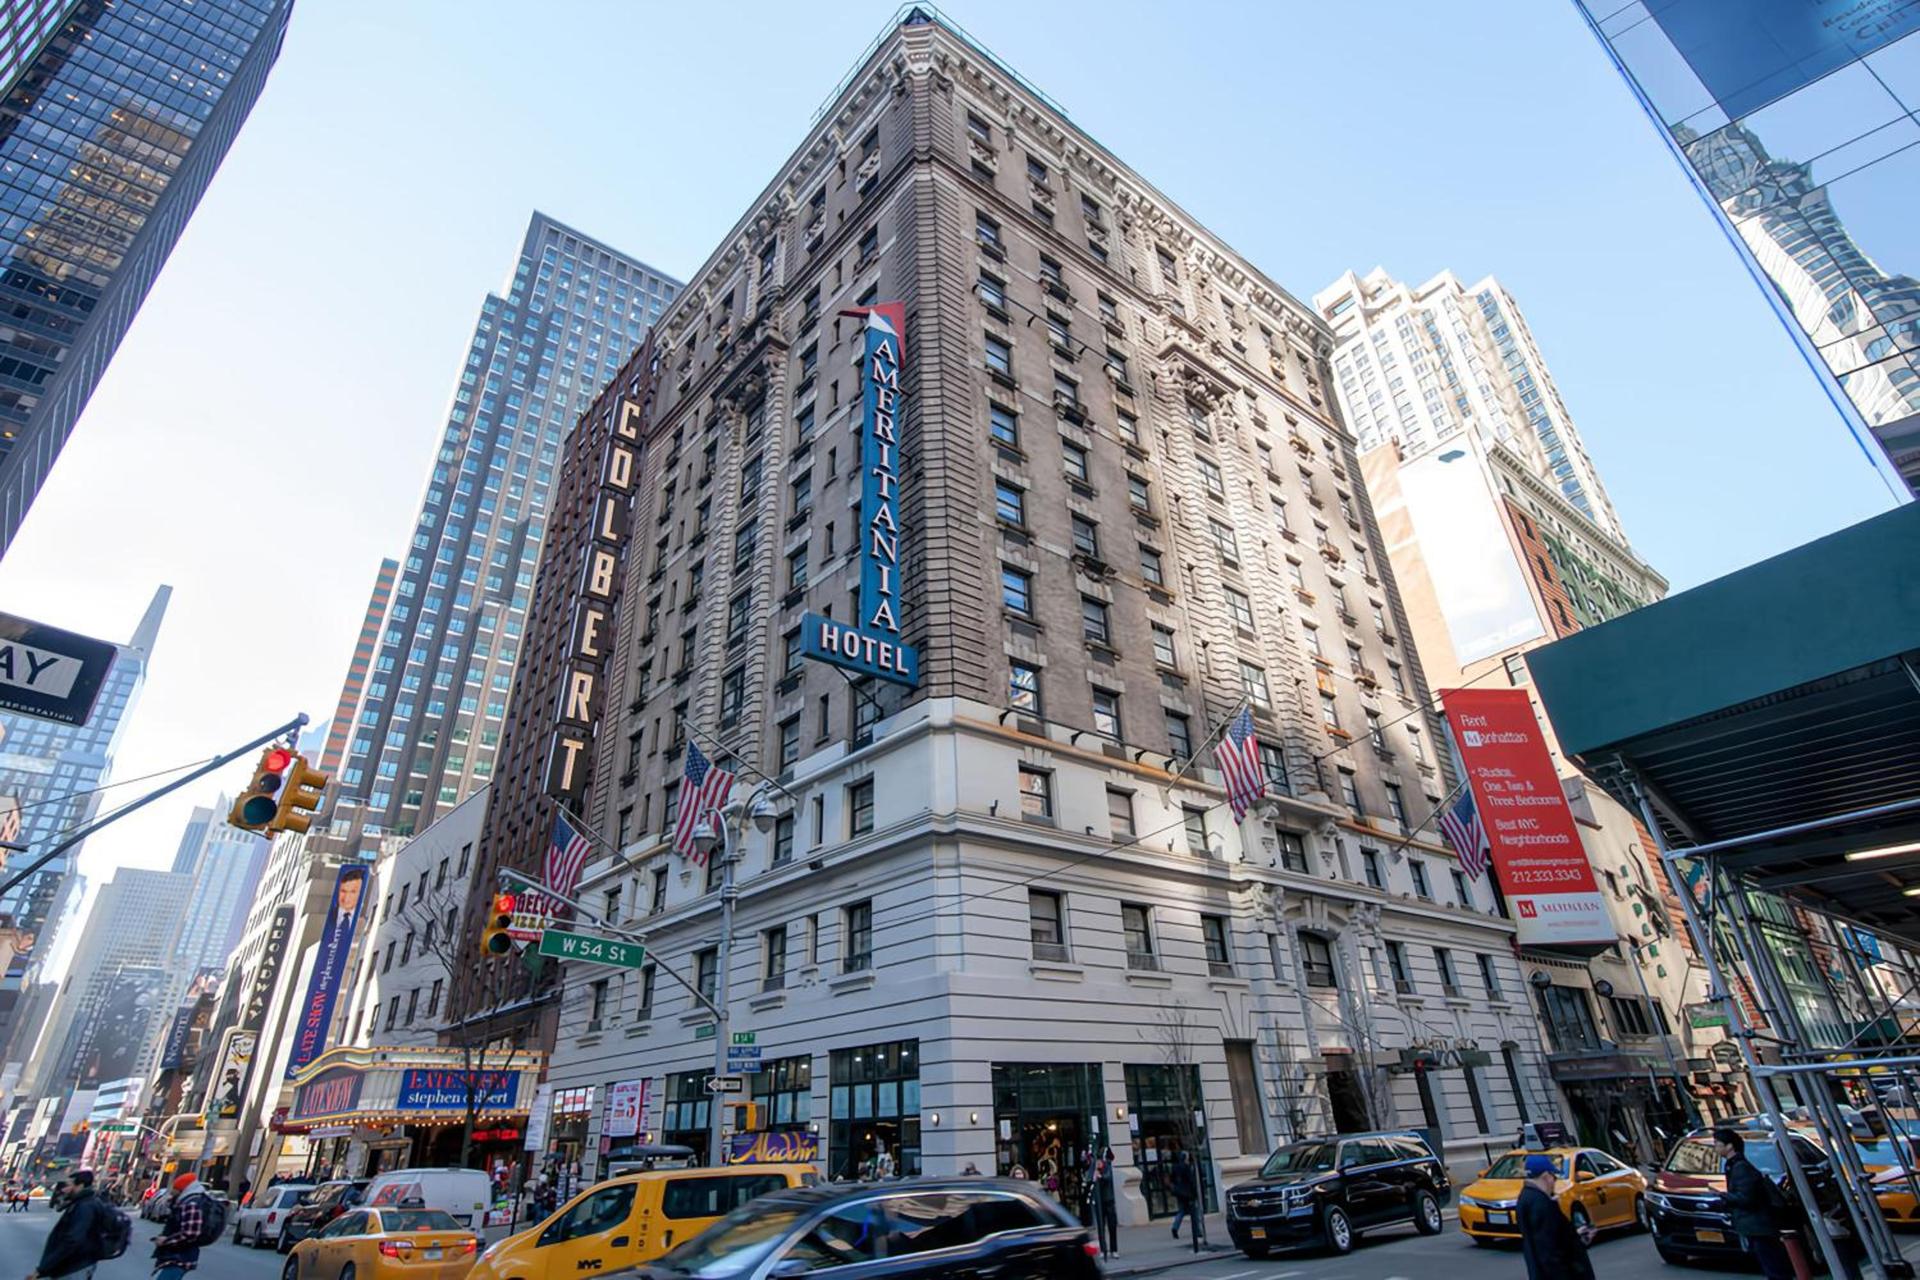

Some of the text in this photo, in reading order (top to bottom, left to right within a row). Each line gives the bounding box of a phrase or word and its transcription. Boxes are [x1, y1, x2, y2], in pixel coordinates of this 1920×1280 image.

[871, 339, 899, 632] AMERITANIA
[560, 400, 641, 792] COLBERT
[820, 623, 909, 675] HOTEL
[1461, 714, 1487, 727] Rent
[1463, 731, 1528, 747] Manhattan
[1488, 795, 1515, 806] Three
[1518, 819, 1539, 829] NYC
[1500, 834, 1569, 847] Neighborhoods
[563, 938, 627, 962] W 54 St
[250, 917, 288, 1020] BROADWAY
[307, 991, 327, 1028] SHOW
[298, 1026, 318, 1063] LATE
[408, 1071, 460, 1089] LATE
[408, 1089, 459, 1109] stephen
[730, 1131, 817, 1163] Aladdin
[577, 1259, 602, 1270] NYC
